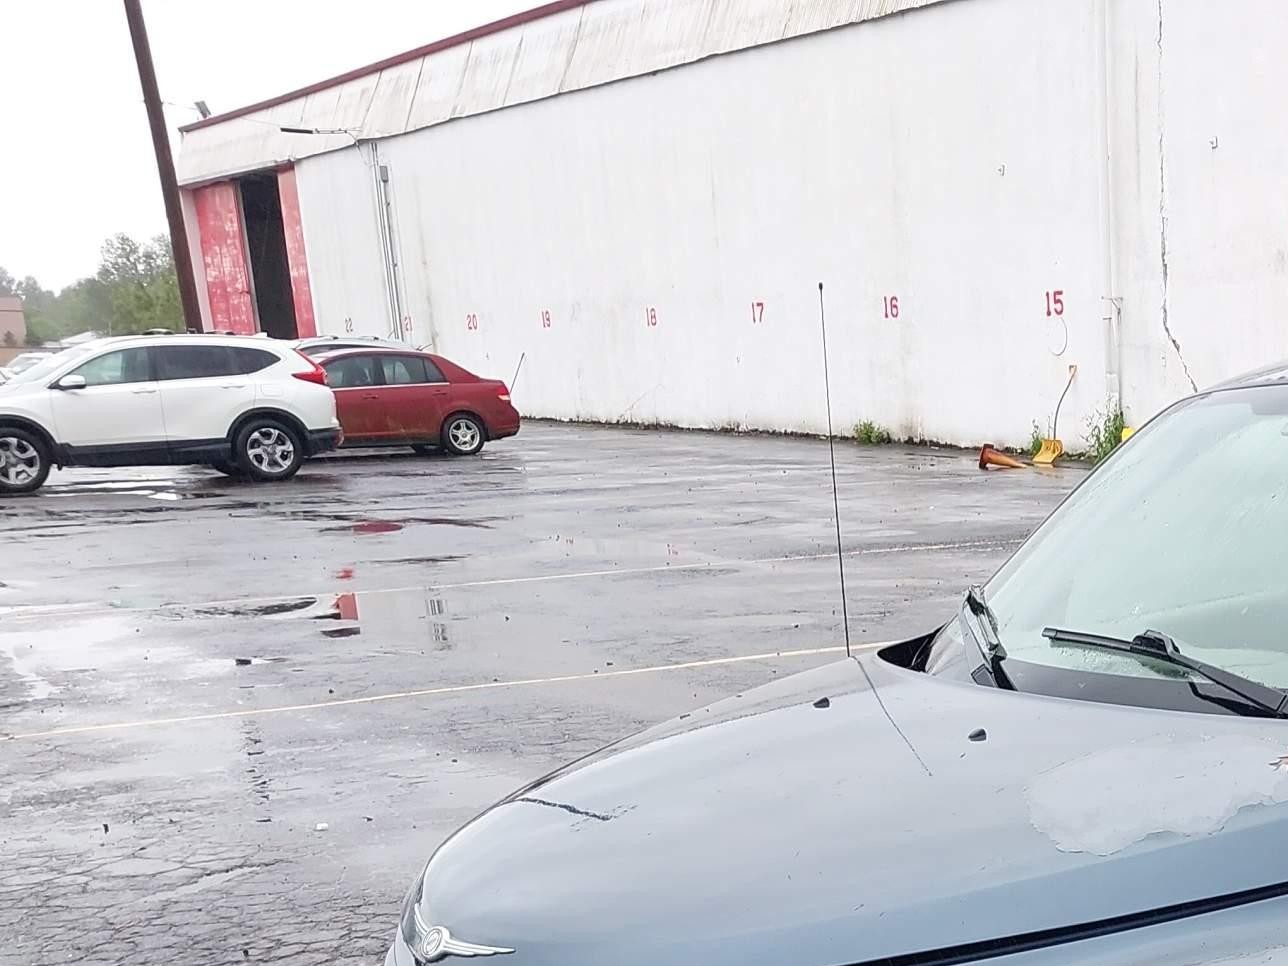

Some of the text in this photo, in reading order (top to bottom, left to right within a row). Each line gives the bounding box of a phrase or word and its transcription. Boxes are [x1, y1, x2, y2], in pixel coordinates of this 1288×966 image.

[750, 302, 766, 324] 17
[882, 296, 900, 318] 16
[1045, 291, 1065, 315] 15
[466, 314, 478, 331] 20
[541, 310, 551, 329] 19
[645, 307, 658, 327] 18
